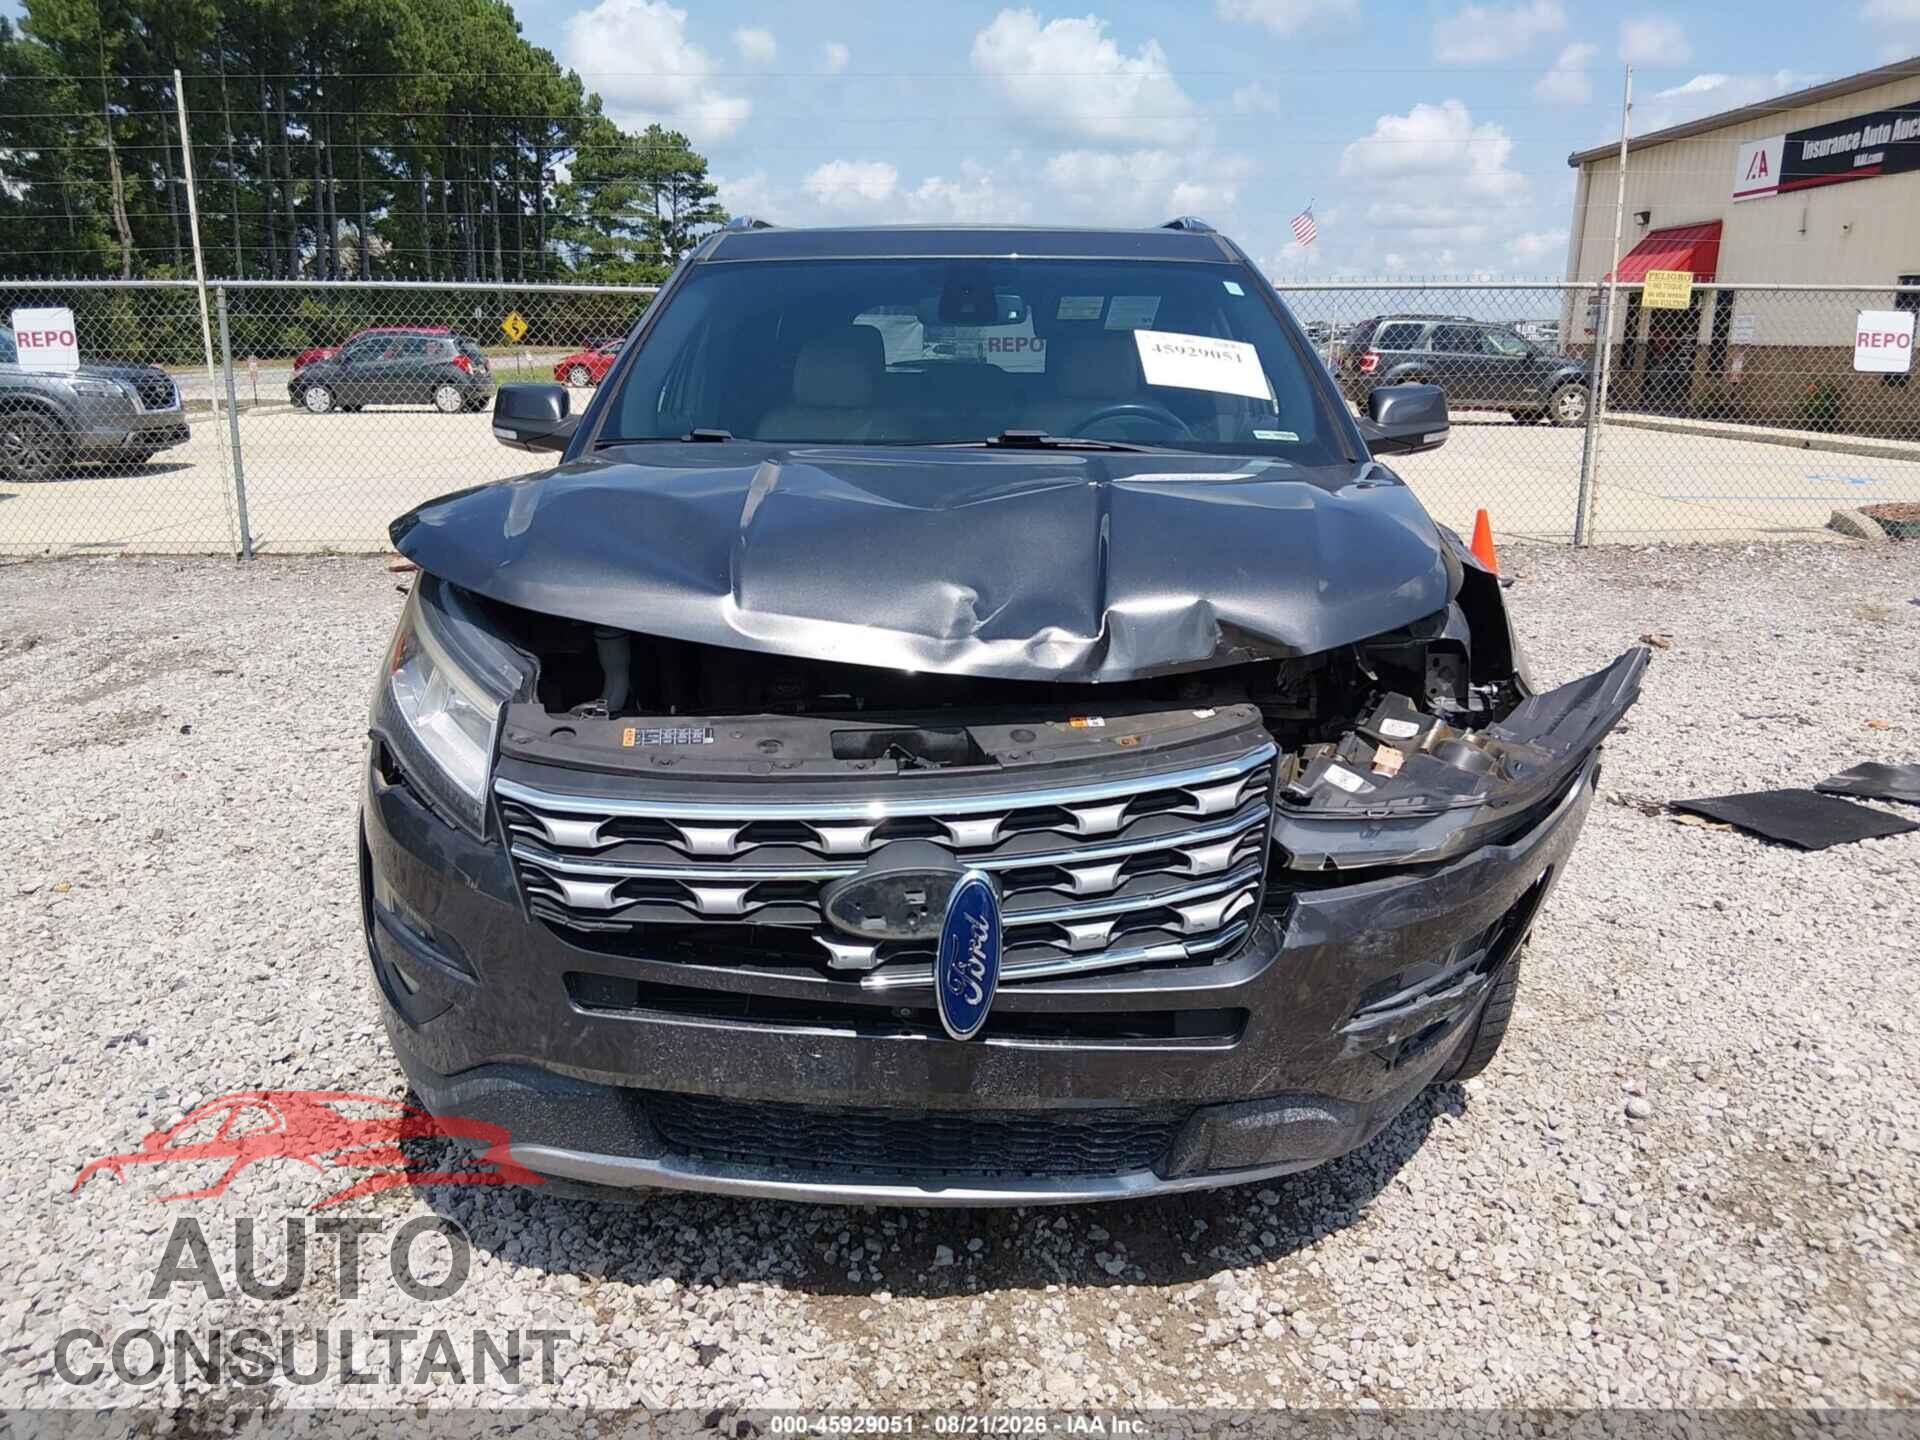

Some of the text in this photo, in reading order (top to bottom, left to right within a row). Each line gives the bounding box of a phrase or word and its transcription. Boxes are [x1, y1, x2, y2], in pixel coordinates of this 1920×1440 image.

[1801, 130, 1862, 161] Insurance
[1860, 123, 1892, 148] Auto
[1648, 272, 1692, 281] PELIGRO
[16, 330, 75, 348] REPO
[988, 336, 1044, 353] REPO
[1857, 332, 1910, 349] REPO
[1152, 343, 1243, 363] 45929051
[947, 911, 989, 1006] Ford
